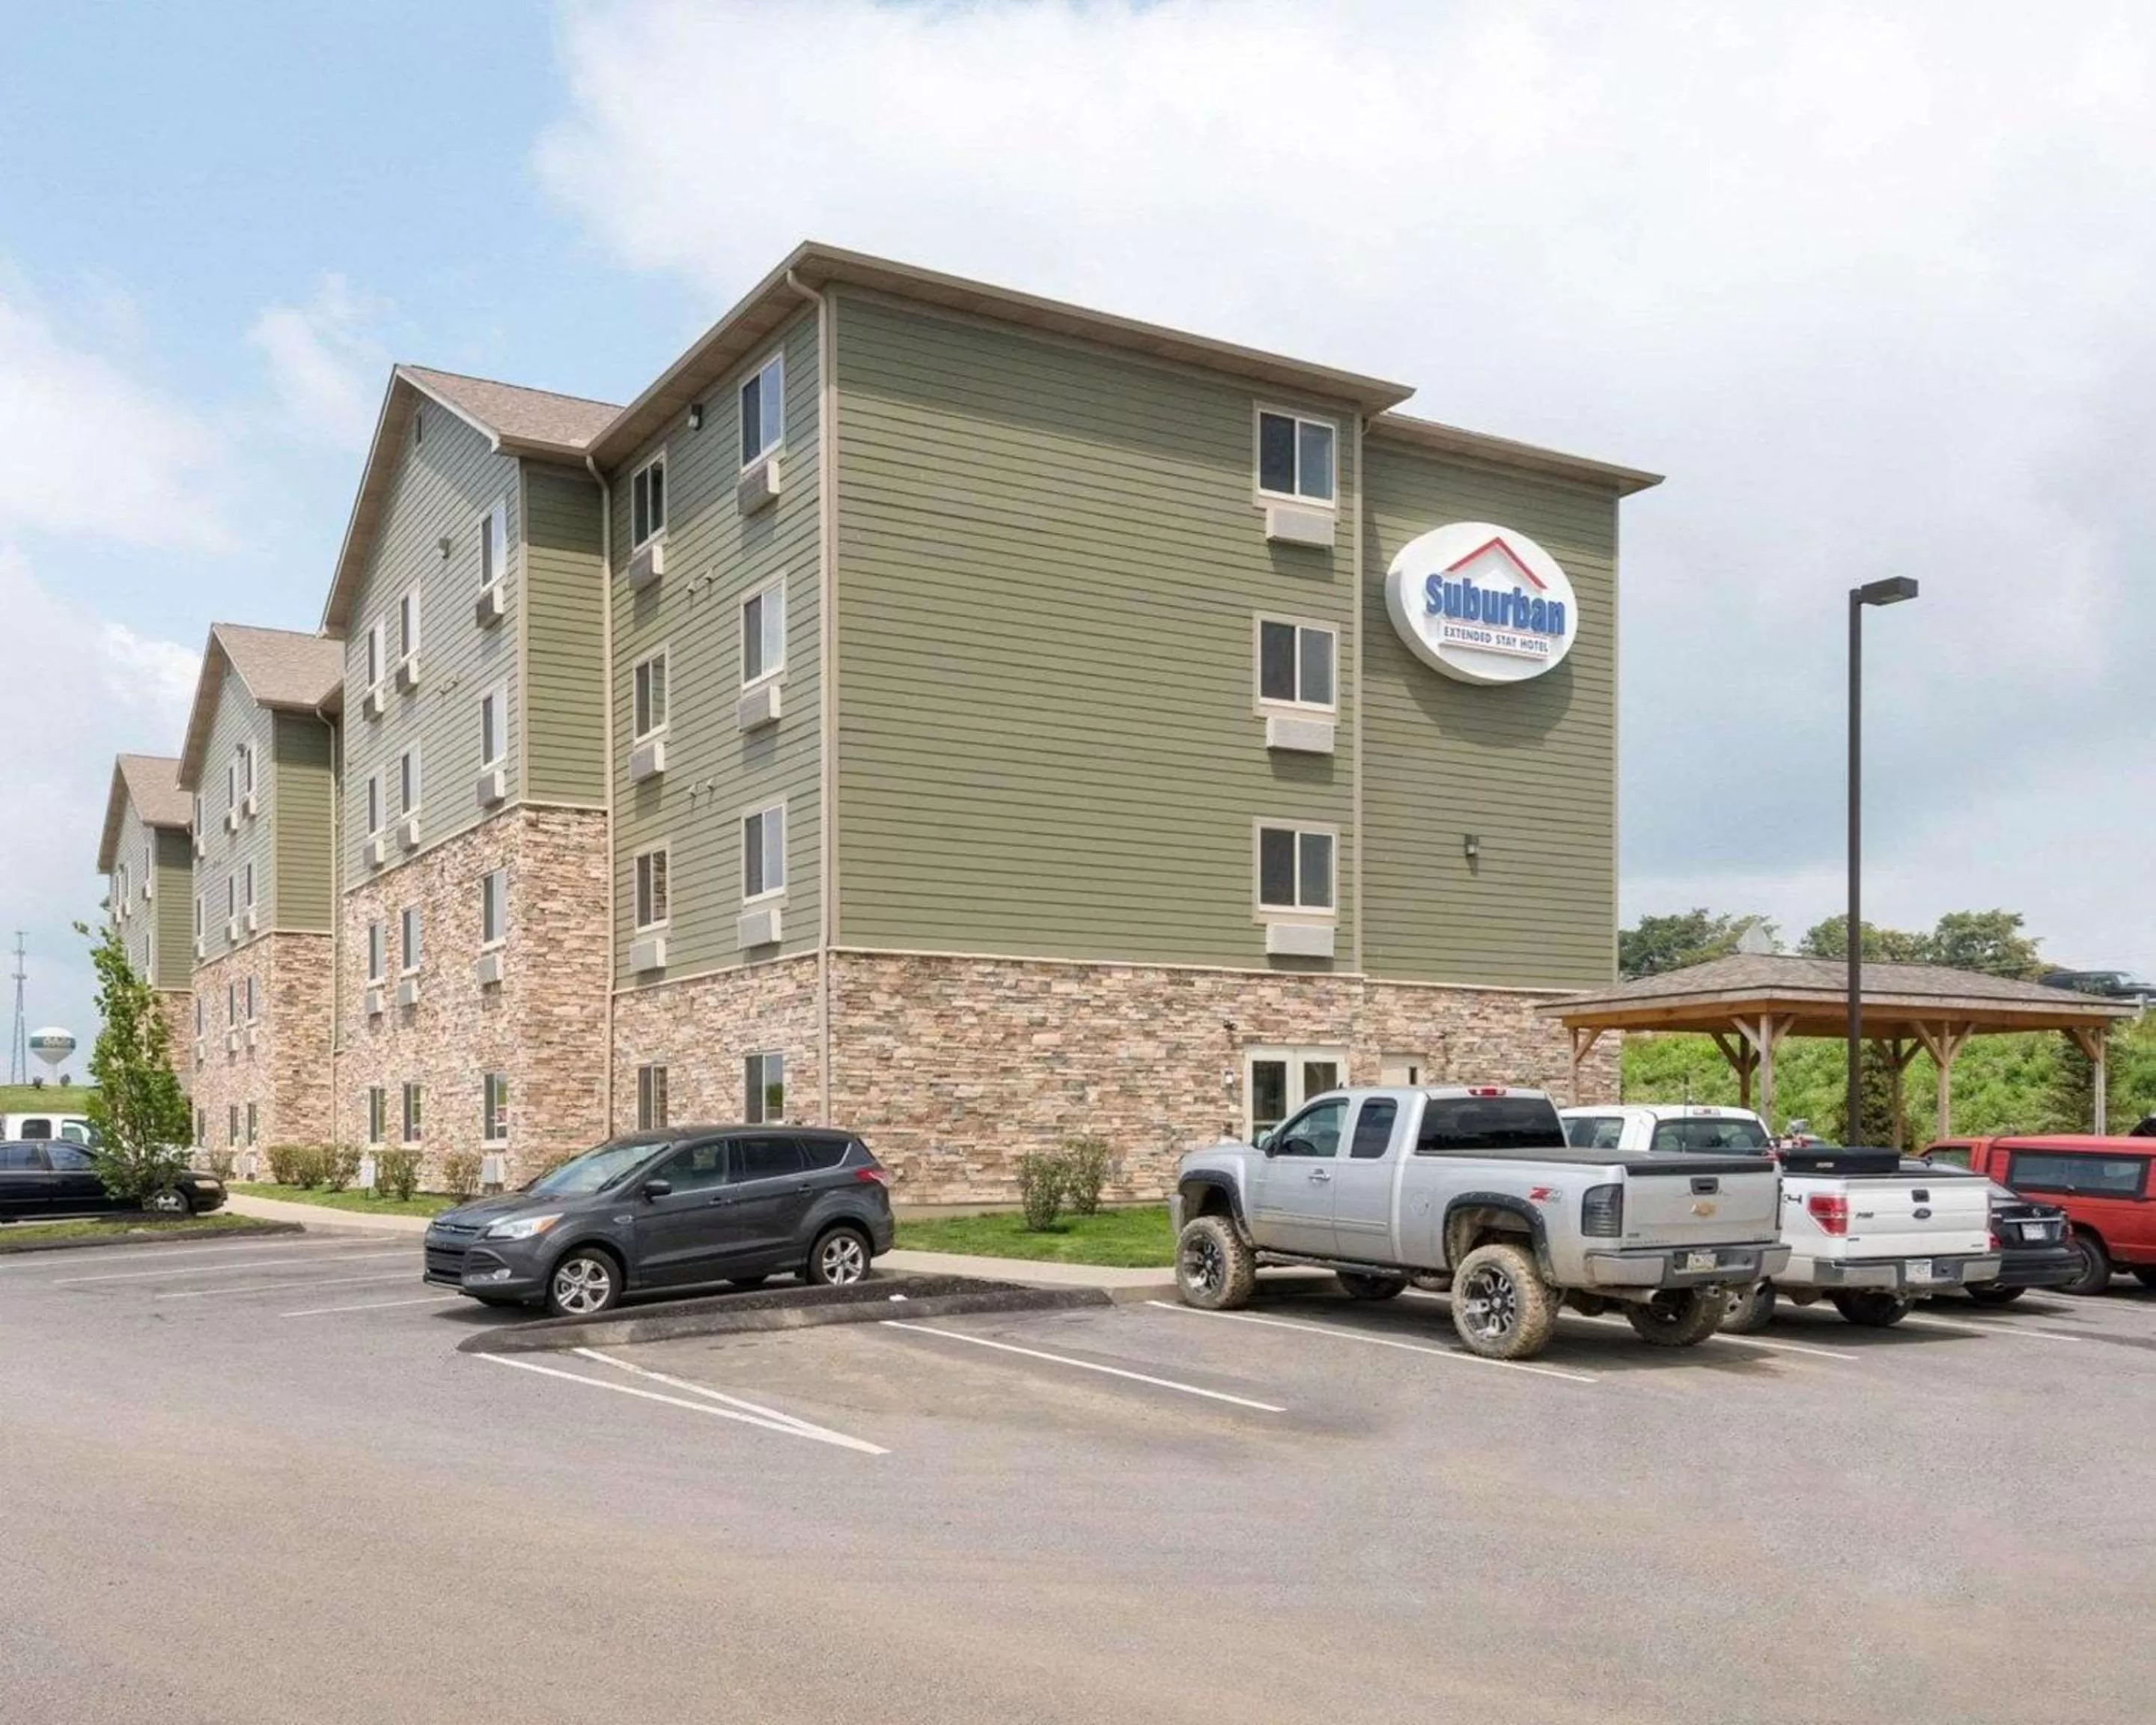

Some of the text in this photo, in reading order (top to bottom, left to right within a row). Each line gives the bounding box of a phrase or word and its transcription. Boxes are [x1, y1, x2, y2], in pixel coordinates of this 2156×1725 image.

[1426, 574, 1565, 635] Suburban
[1444, 626, 1548, 652] EXTENDED STAY HOTEL
